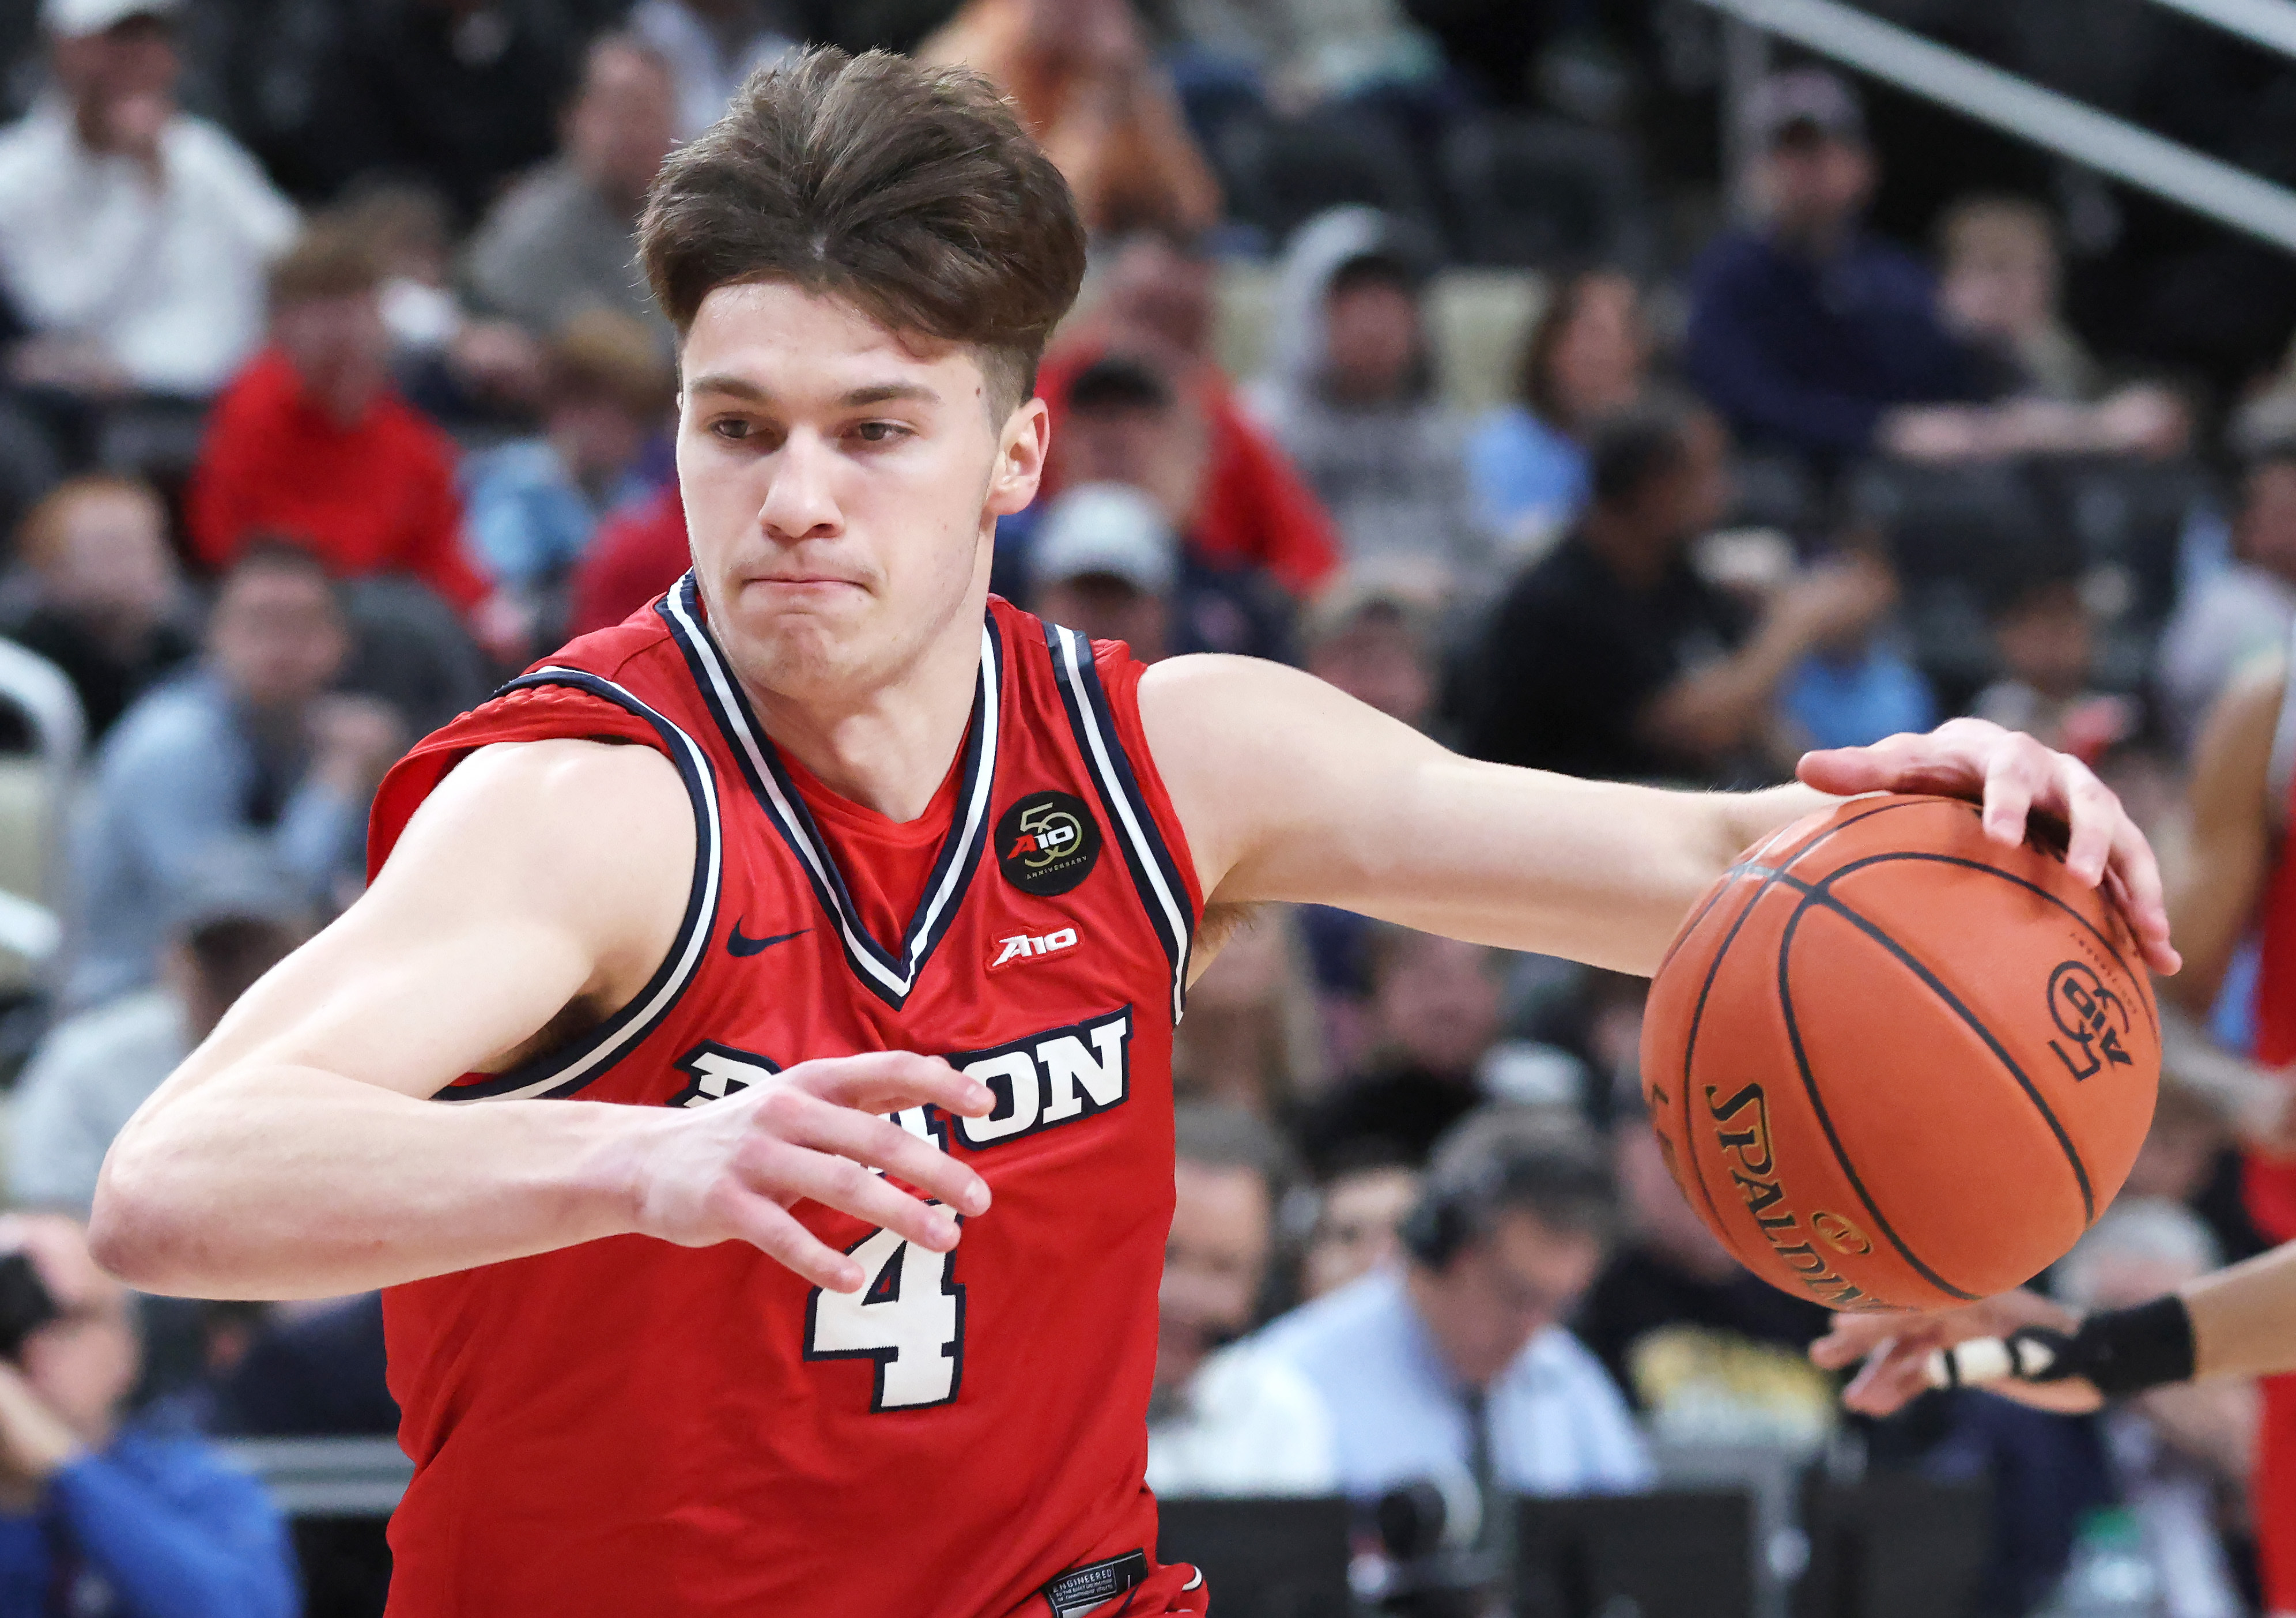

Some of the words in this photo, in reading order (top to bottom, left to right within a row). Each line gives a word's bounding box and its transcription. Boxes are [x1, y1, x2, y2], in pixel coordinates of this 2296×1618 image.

[1007, 825, 1074, 859] A10
[992, 927, 1078, 967] A10
[1704, 1082, 1919, 1311] SPALDIN
[804, 1200, 966, 1413] 4
